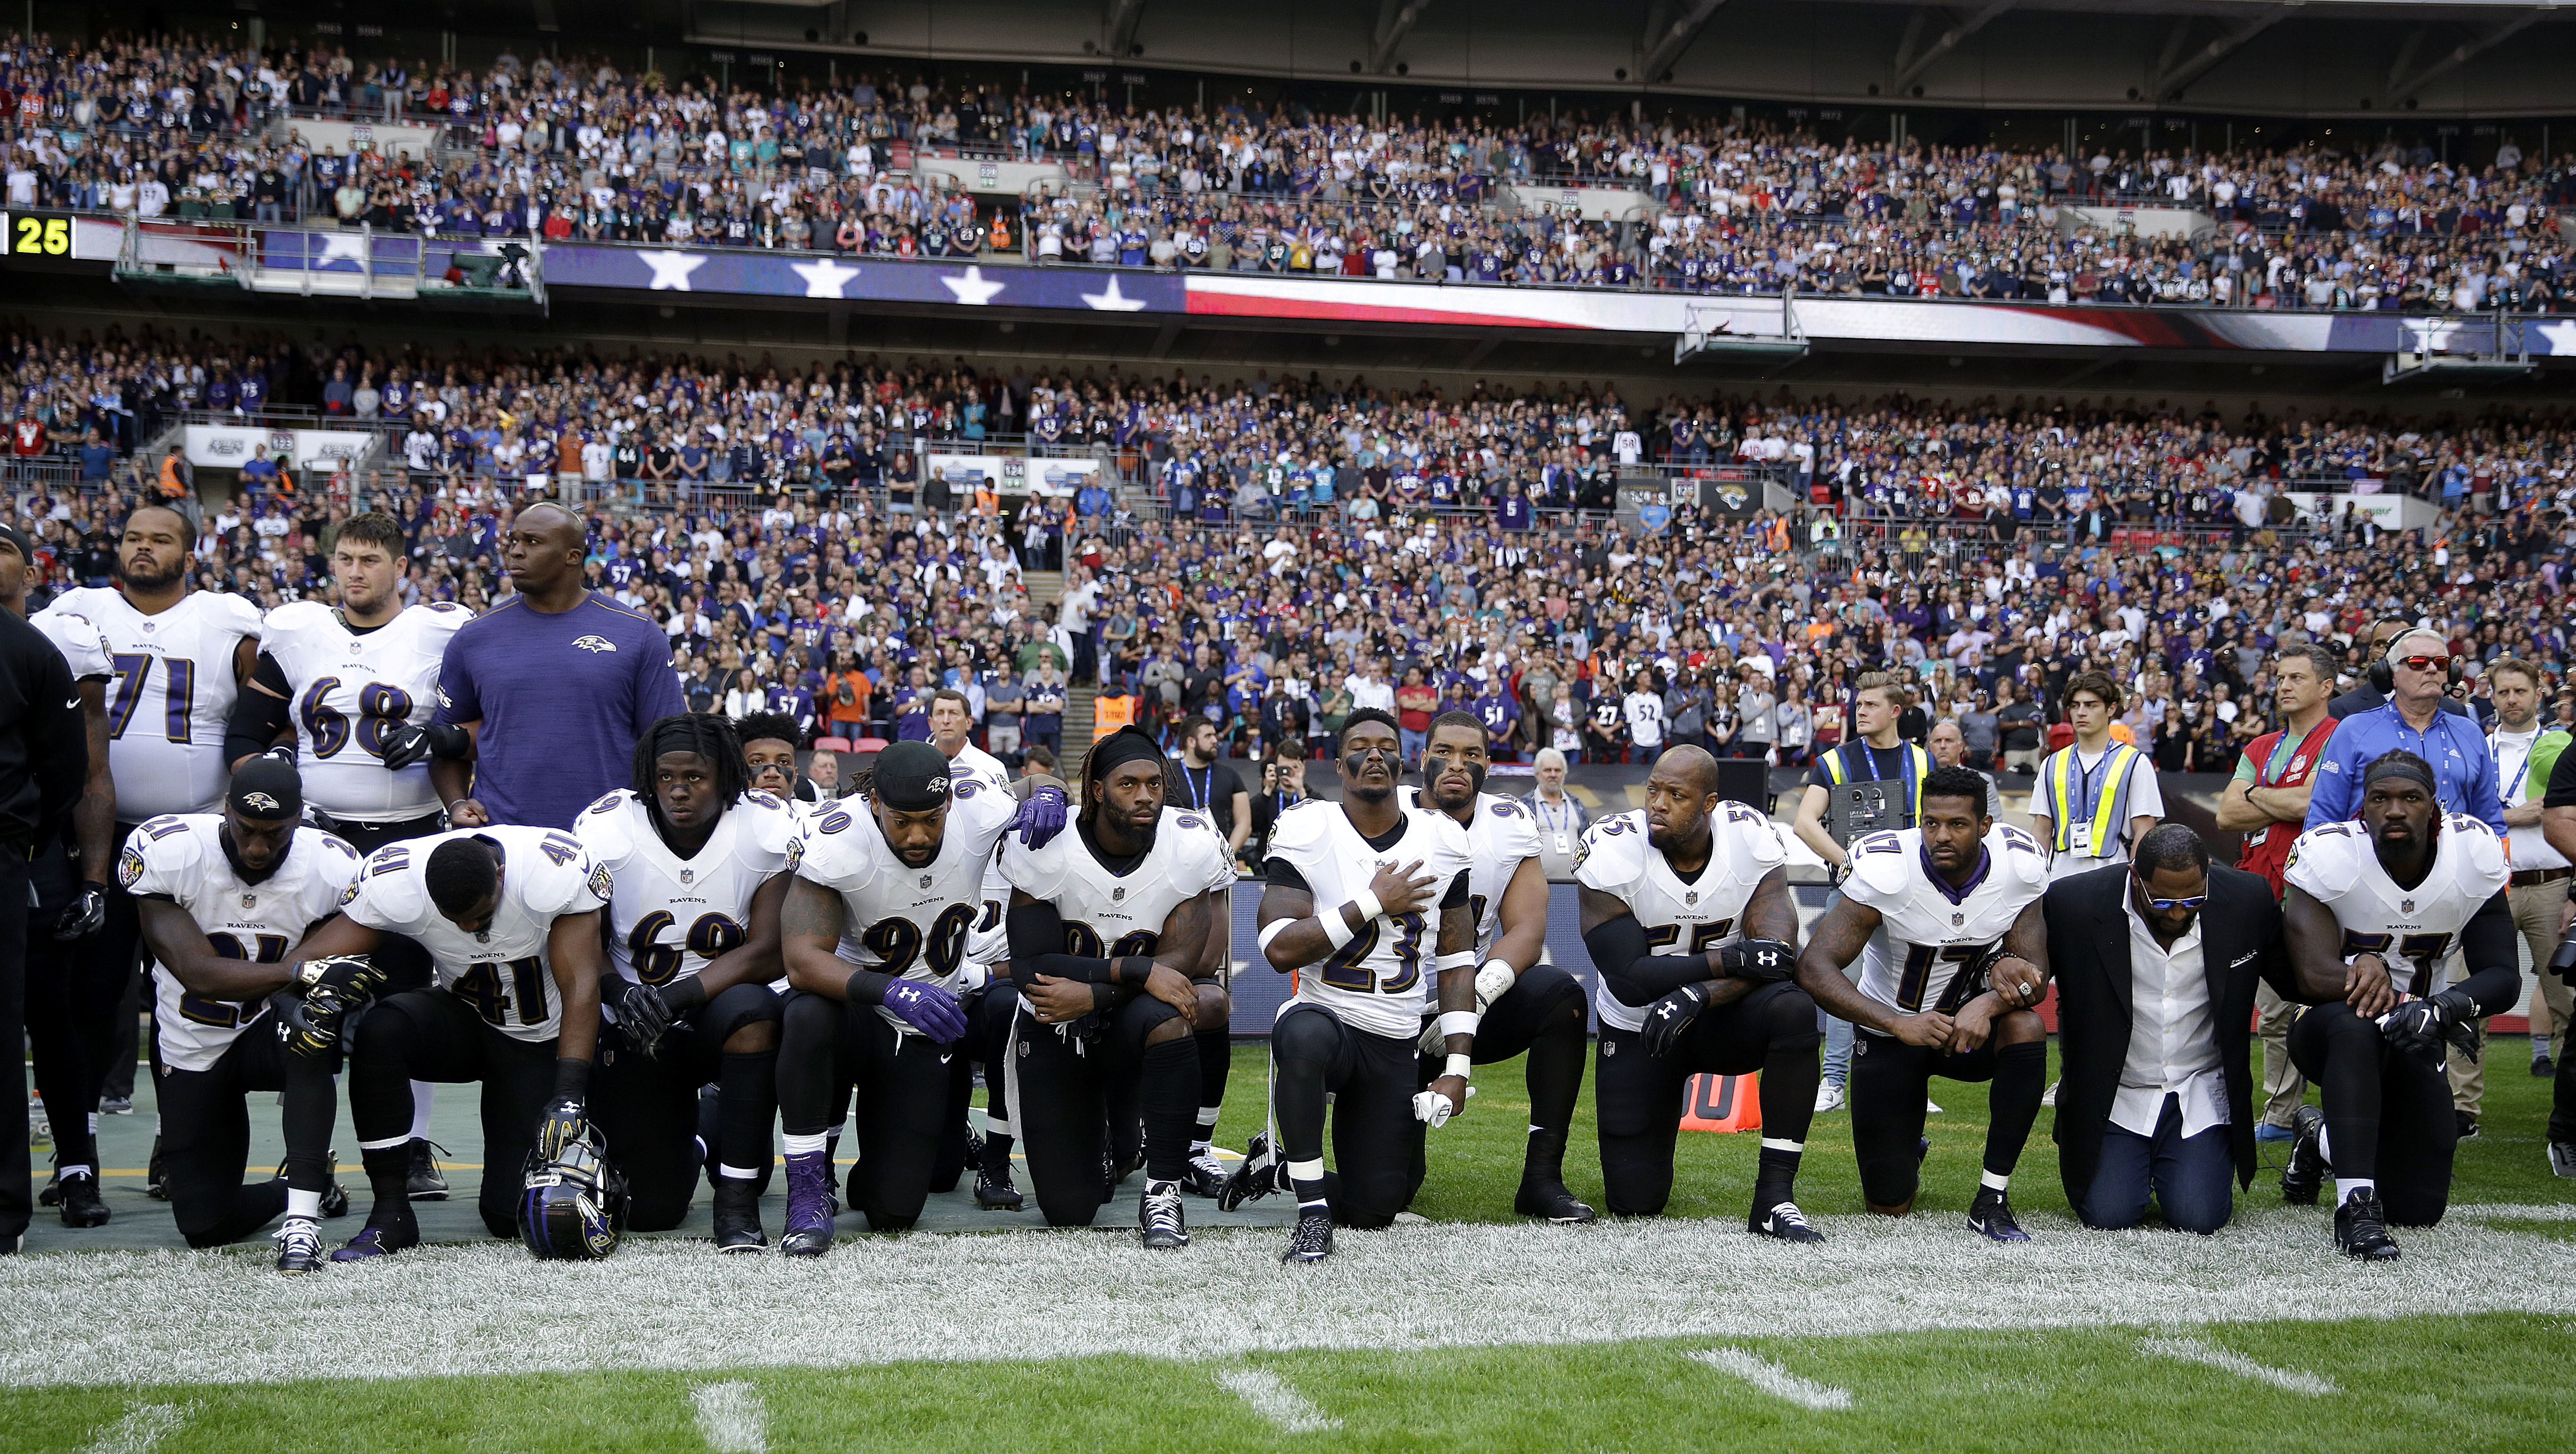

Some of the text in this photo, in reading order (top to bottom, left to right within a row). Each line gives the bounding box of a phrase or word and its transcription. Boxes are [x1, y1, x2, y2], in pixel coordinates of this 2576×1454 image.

[16, 217, 69, 255] 25
[729, 221, 746, 238] 12
[929, 233, 942, 248] 12
[1615, 267, 1624, 281] 5
[1895, 275, 1910, 287] 40
[1043, 418, 1057, 432] 92
[1622, 438, 1635, 449] 58
[619, 448, 637, 463] 44
[1004, 464, 1025, 476] 124
[1859, 472, 1869, 487] 5
[1927, 479, 1937, 492] 7
[1966, 490, 1982, 505] 10
[2018, 491, 2029, 509] 10
[1507, 500, 1517, 517] 5
[612, 565, 632, 584] 57
[2174, 576, 2185, 592] 5
[132, 643, 166, 653] RAVENS
[342, 662, 377, 674] RAVENS
[109, 653, 194, 744] 71
[779, 695, 799, 716] 57
[301, 676, 413, 760] 68
[1485, 706, 1504, 726] 51
[1597, 706, 1618, 726] 27
[1639, 705, 1655, 721] 52
[809, 801, 853, 834] 90
[139, 816, 190, 842] 21
[540, 832, 582, 867] 41
[1862, 833, 1902, 854] 17
[2004, 827, 2035, 855] 17
[372, 847, 410, 877] 41
[911, 896, 945, 908] RAVENS
[1097, 913, 1133, 921] RAVENS
[628, 910, 746, 985] 69
[861, 902, 978, 978] 90
[1321, 911, 1428, 995] 23
[2344, 928, 2453, 997] 57
[1896, 944, 1992, 1013] 17
[451, 956, 550, 1026] 41
[1249, 1151, 1271, 1175] NIKE
